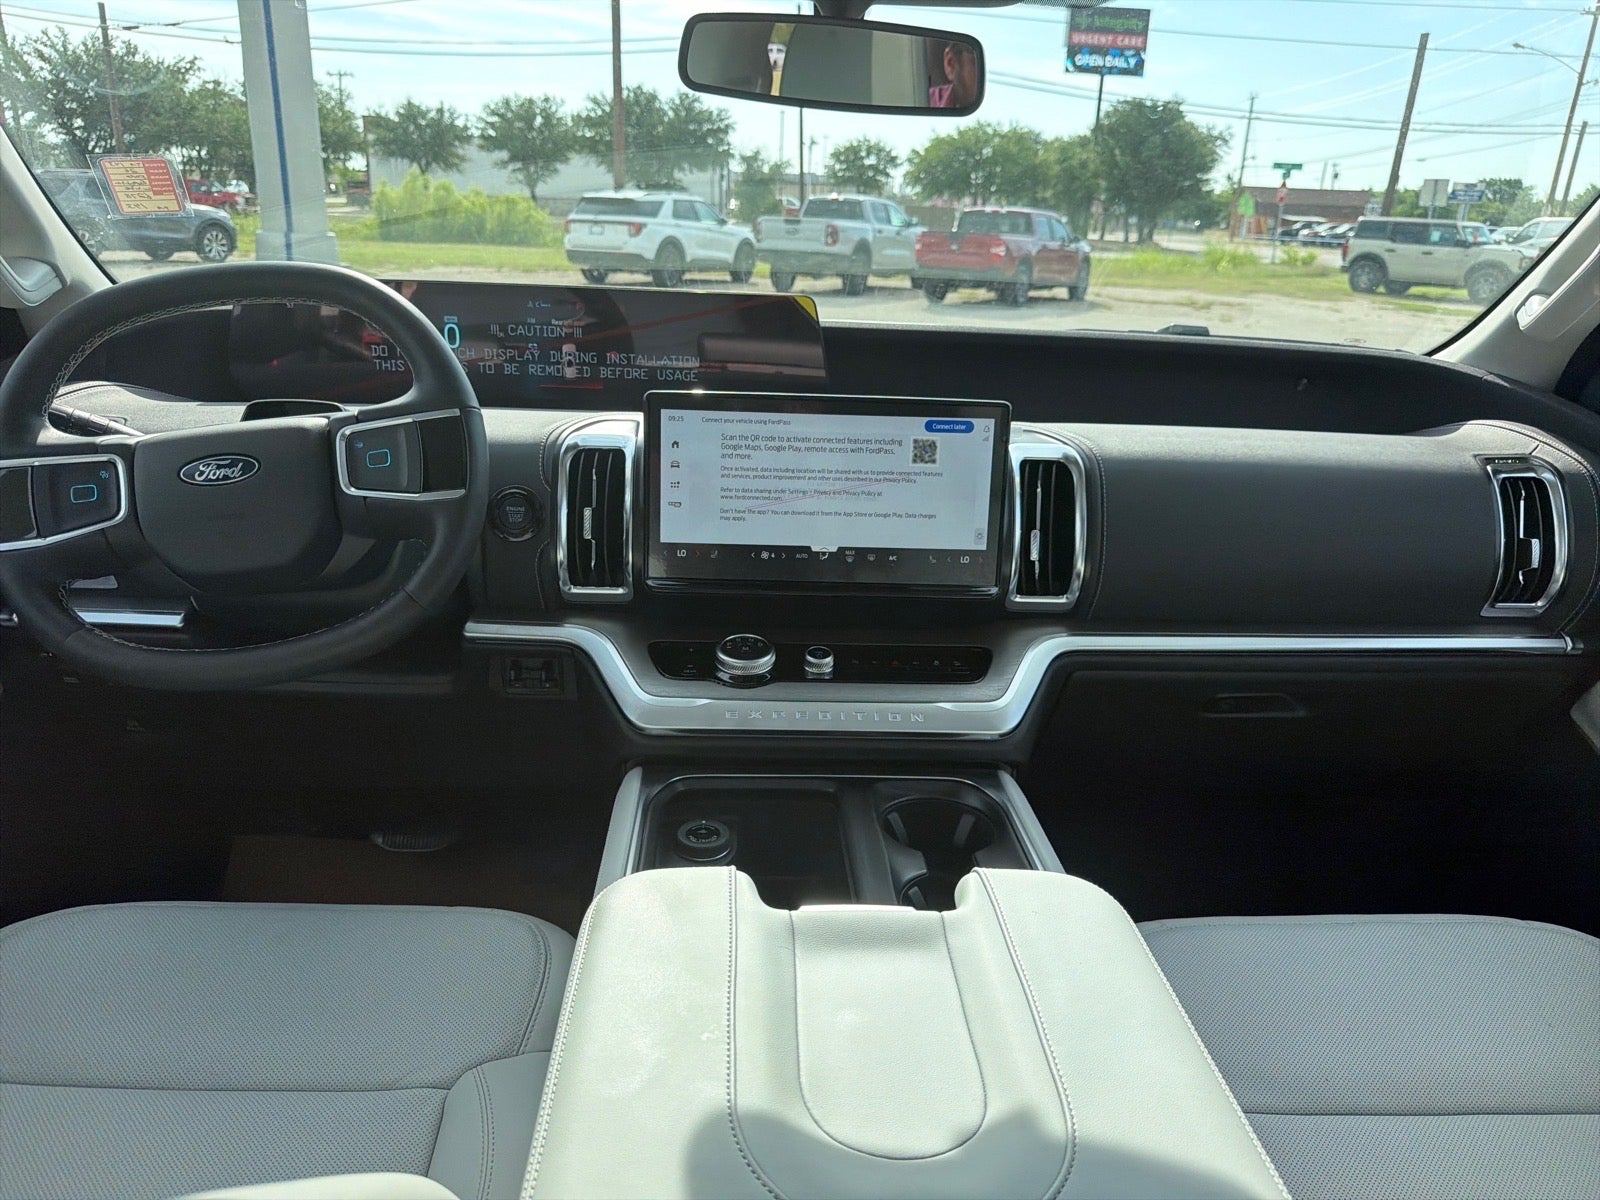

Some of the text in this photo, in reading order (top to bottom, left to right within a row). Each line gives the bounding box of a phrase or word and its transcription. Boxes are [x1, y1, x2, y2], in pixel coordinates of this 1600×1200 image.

[1072, 33, 1145, 47] URGENT CARE
[1074, 54, 1137, 68] OPEN DAILY
[508, 324, 564, 337] CAUTION
[371, 345, 388, 357] DO
[484, 348, 540, 361] DISPLAY
[550, 350, 598, 364] DURING
[606, 353, 700, 367] INSTALLATION
[374, 360, 405, 371] THIS
[478, 362, 494, 374] TO
[504, 364, 520, 375] BE
[600, 367, 648, 379] BEFORE
[658, 370, 698, 381] USAGE
[750, 434, 760, 442] QR
[813, 436, 845, 444] connected
[874, 438, 902, 446] including
[721, 443, 743, 451] Google
[745, 444, 763, 452] Maps,
[764, 444, 786, 453] Google
[788, 445, 802, 453] Play,
[866, 446, 895, 455] FordPass,
[194, 460, 244, 480] Ford
[725, 710, 924, 722] EXPEDITION
